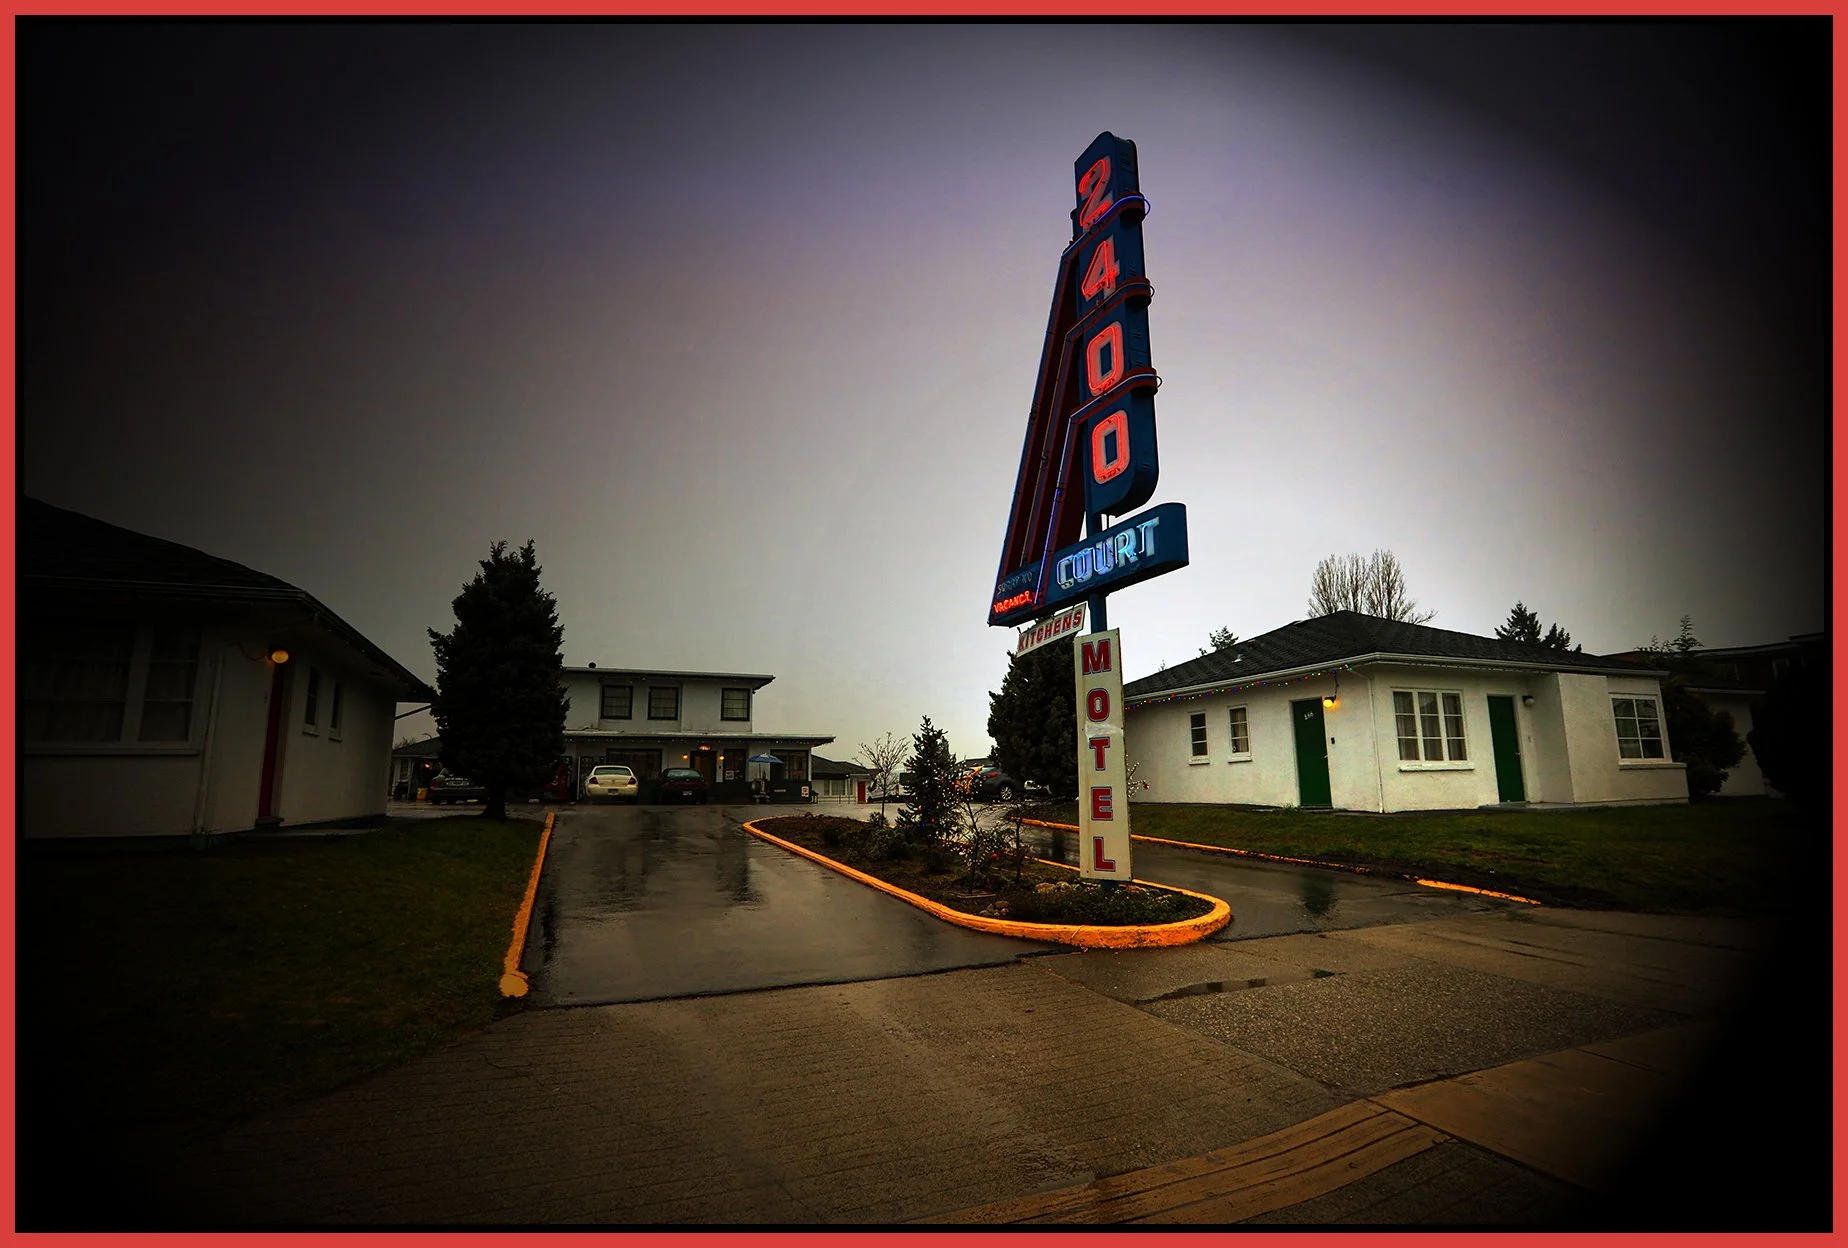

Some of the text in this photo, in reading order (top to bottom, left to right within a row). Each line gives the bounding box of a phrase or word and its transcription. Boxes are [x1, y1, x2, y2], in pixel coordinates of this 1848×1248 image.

[1079, 156, 1131, 484] 2400
[1018, 608, 1082, 651] KITCHENS
[1056, 516, 1160, 590] COURT
[1082, 639, 1116, 872] MOTEL
